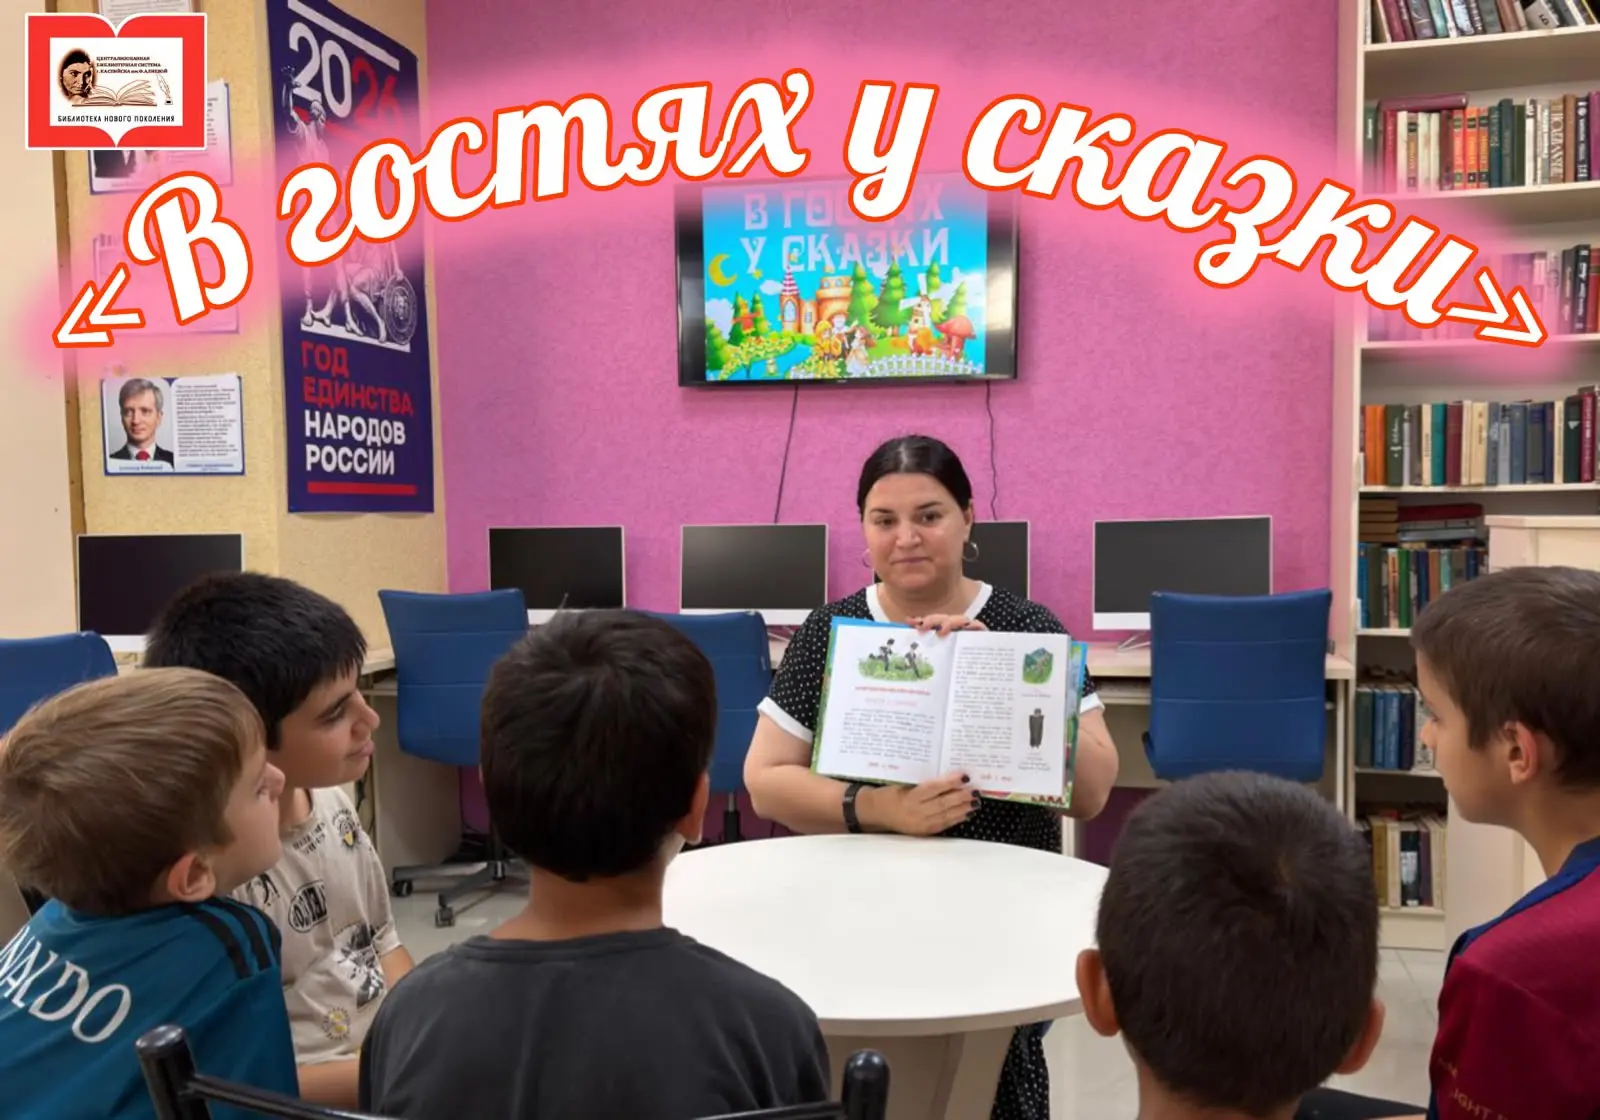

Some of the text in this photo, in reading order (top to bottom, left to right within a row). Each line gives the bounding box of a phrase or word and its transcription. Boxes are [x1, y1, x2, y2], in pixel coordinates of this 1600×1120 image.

[289, 22, 402, 124] 2026
[743, 192, 769, 231] В
[739, 227, 950, 274] У СКАЗКИ
[301, 340, 350, 378] ГОД
[303, 376, 415, 418] ЕДИНСТВА
[304, 409, 407, 448] НАРОДОВ
[305, 443, 396, 476] РОССИИ
